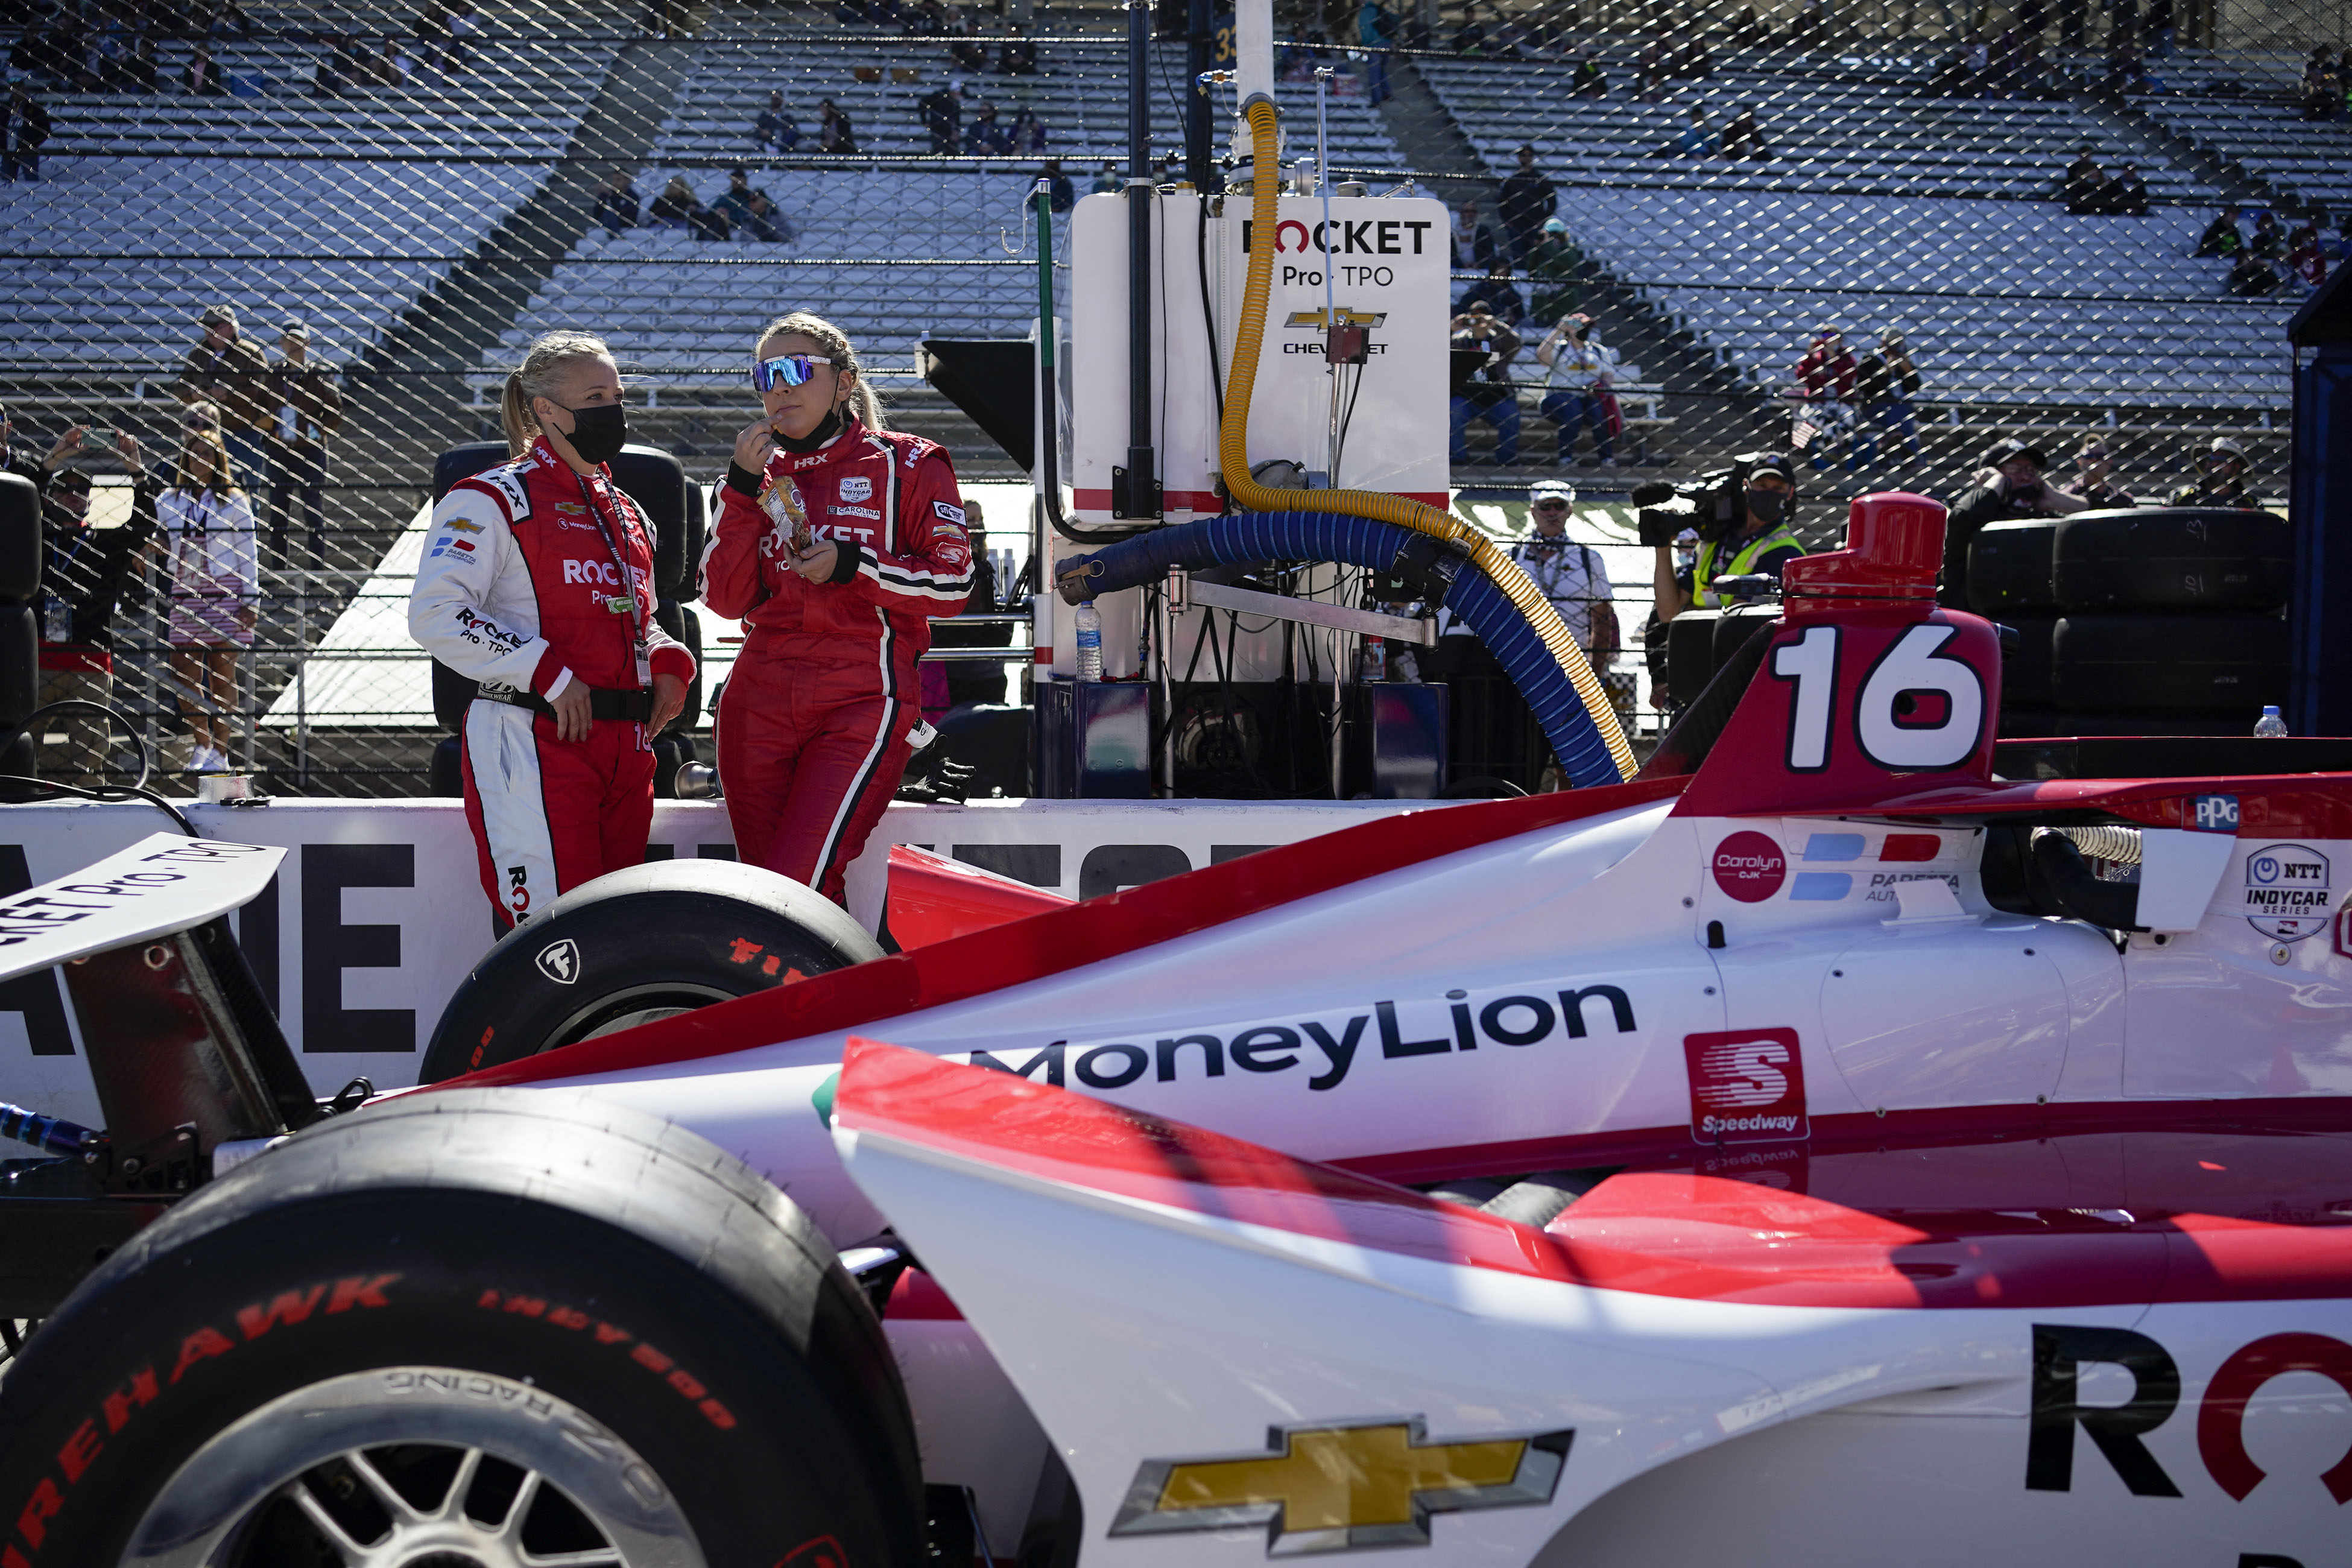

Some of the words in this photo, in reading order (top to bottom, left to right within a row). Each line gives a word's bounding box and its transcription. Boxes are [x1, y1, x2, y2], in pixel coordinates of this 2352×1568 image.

[1283, 266, 1323, 286] Pro
[1341, 266, 1393, 286] TPO
[536, 446, 558, 469] HRX
[794, 453, 829, 470] HRX
[488, 476, 525, 510] HRX
[610, 491, 625, 526] SERIES
[839, 506, 880, 517] CAROLINA
[444, 552, 475, 566] AUTOSPORT
[447, 548, 476, 564] PARETTA
[1771, 624, 1985, 774] 16
[2197, 797, 2239, 828] PPG
[56, 873, 186, 896] Pro
[140, 842, 267, 863] TPO
[1717, 853, 1781, 870] Carolyn
[2284, 863, 2322, 880] NTT
[1739, 871, 1760, 880] CJK
[2246, 890, 2328, 906] INDYCAR
[2263, 906, 2310, 915] SERIES
[970, 984, 1637, 1091] MoneyLion
[1702, 1114, 1798, 1136] Speedway
[382, 1371, 552, 1422] RACING
